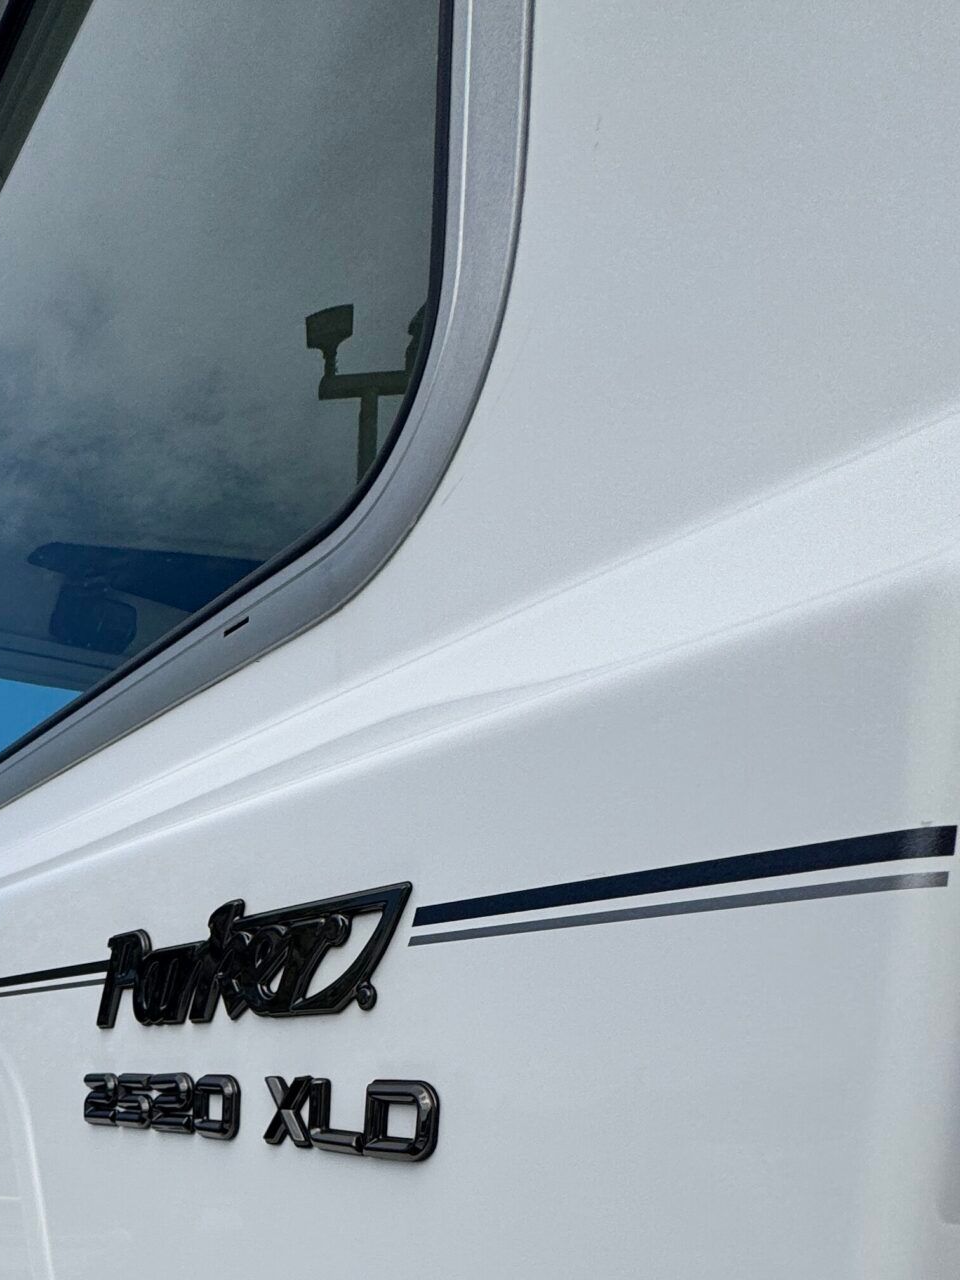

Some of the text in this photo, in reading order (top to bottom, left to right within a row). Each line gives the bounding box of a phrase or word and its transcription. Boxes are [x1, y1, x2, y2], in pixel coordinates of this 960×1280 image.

[96, 881, 413, 1029] Parker
[83, 1072, 440, 1162] 2520 XLD
